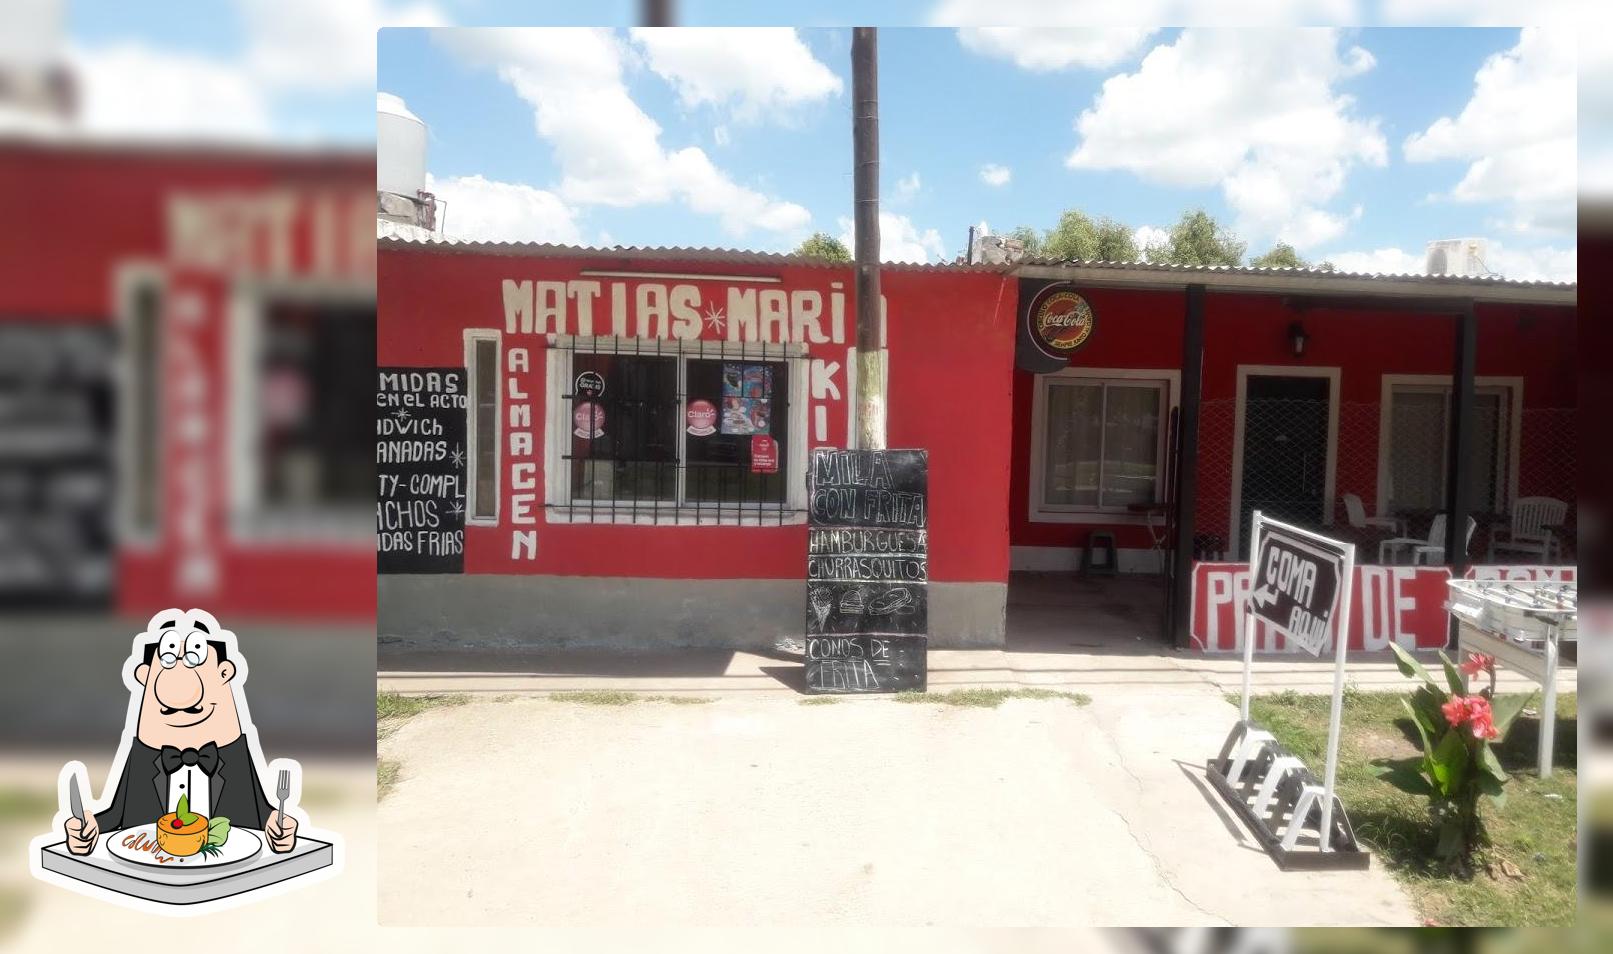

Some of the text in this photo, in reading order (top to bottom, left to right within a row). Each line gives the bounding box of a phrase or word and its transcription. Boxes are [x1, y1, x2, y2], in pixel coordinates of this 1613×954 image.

[502, 279, 703, 340] MATIAS
[687, 409, 713, 418] Claro
[508, 348, 537, 560] ALMACEN
[815, 450, 895, 490] MILA
[811, 488, 857, 523] CON
[417, 529, 464, 556] FRIAS
[808, 557, 928, 580] CHURRASQUITOS
[1265, 546, 1318, 609] COMA
[1360, 566, 1417, 653] DE
[809, 638, 891, 660] CONOS DE
